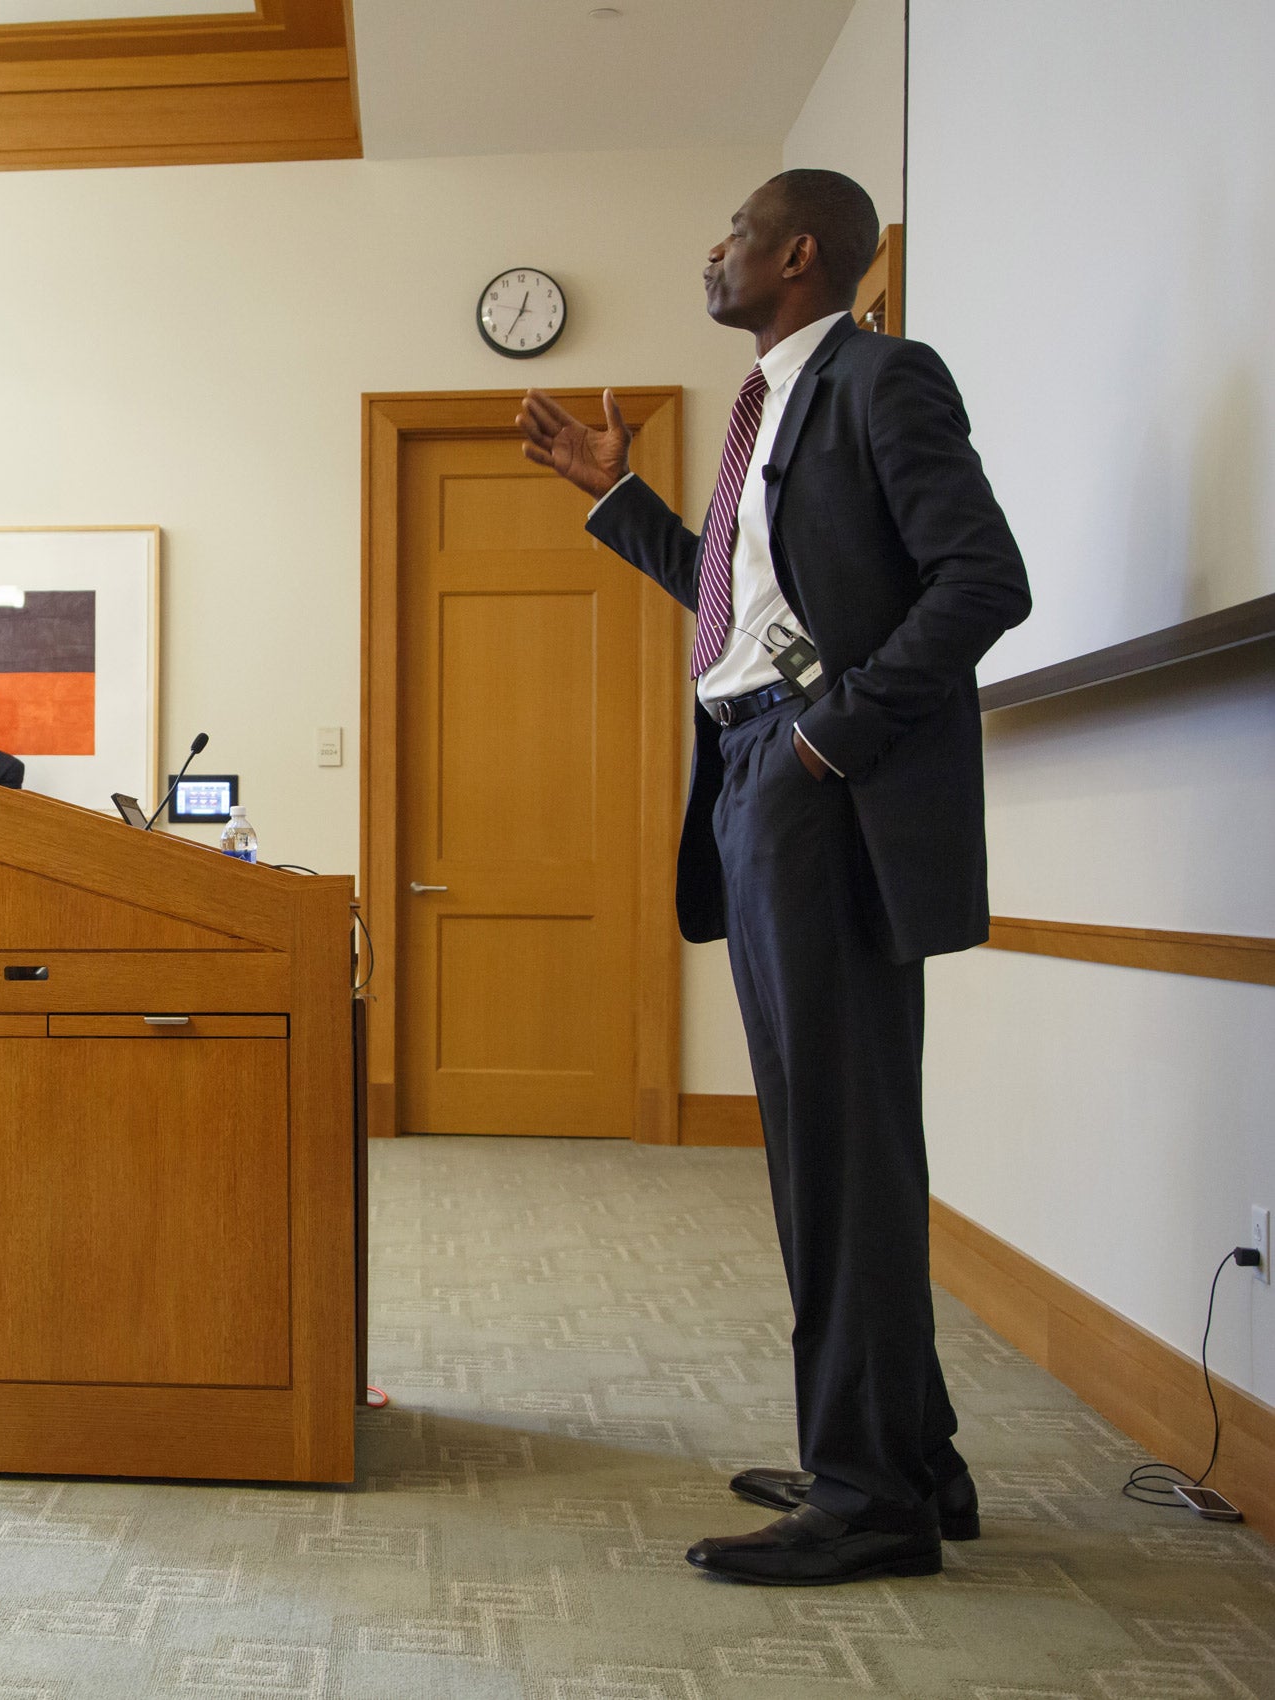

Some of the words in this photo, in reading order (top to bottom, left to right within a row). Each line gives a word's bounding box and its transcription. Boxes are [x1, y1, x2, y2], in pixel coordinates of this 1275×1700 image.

[517, 274, 525, 283] 12
[536, 278, 540, 286] 1
[502, 280, 509, 288] 11
[490, 292, 498, 301] 10
[547, 289, 553, 298] 2
[487, 308, 492, 316] 9
[552, 305, 557, 313] 3
[492, 324, 497, 333] 8
[548, 321, 553, 329] 4
[505, 334, 509, 343] 7
[536, 333, 541, 342] 5
[520, 338, 525, 347] 6
